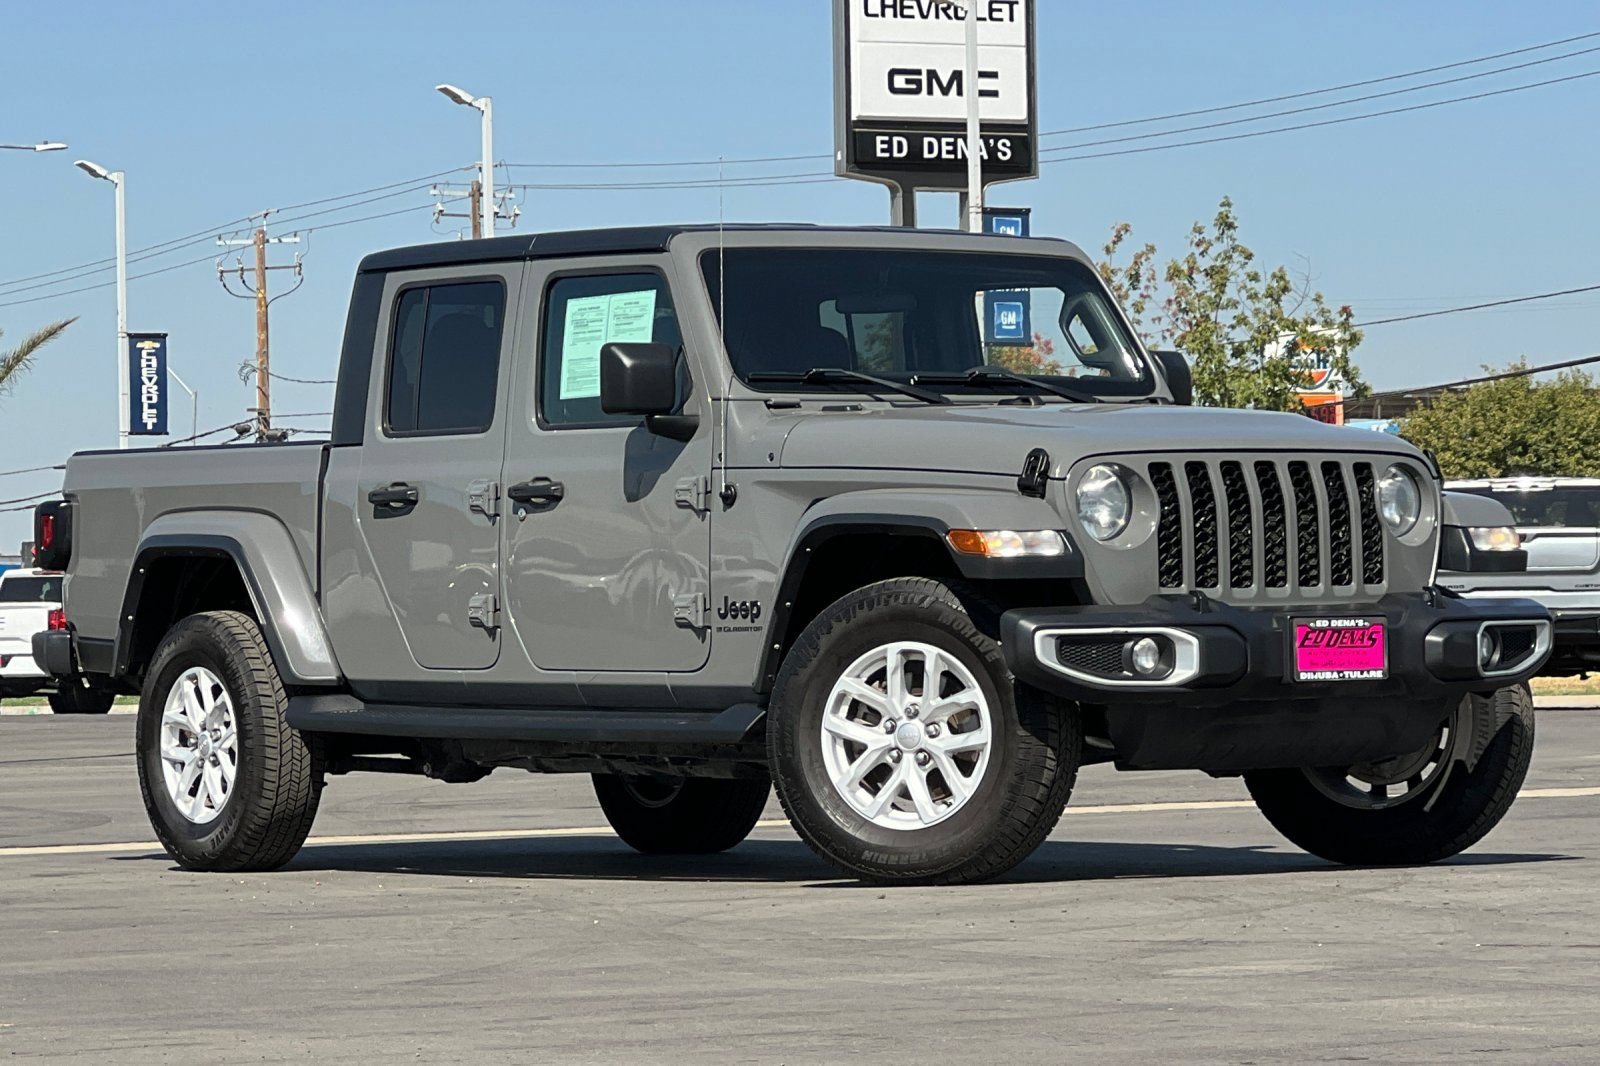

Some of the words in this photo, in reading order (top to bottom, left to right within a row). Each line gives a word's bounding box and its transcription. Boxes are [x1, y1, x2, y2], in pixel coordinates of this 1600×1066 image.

[888, 68, 999, 98] GMC
[875, 136, 908, 158] ED
[1001, 311, 1016, 325] GM
[141, 349, 159, 430] CHEVROLET
[718, 596, 761, 623] Jeep
[1316, 619, 1329, 627] ED
[1331, 619, 1364, 627] DENA'S
[1298, 630, 1327, 648] ED
[1343, 670, 1383, 678] TULARE
